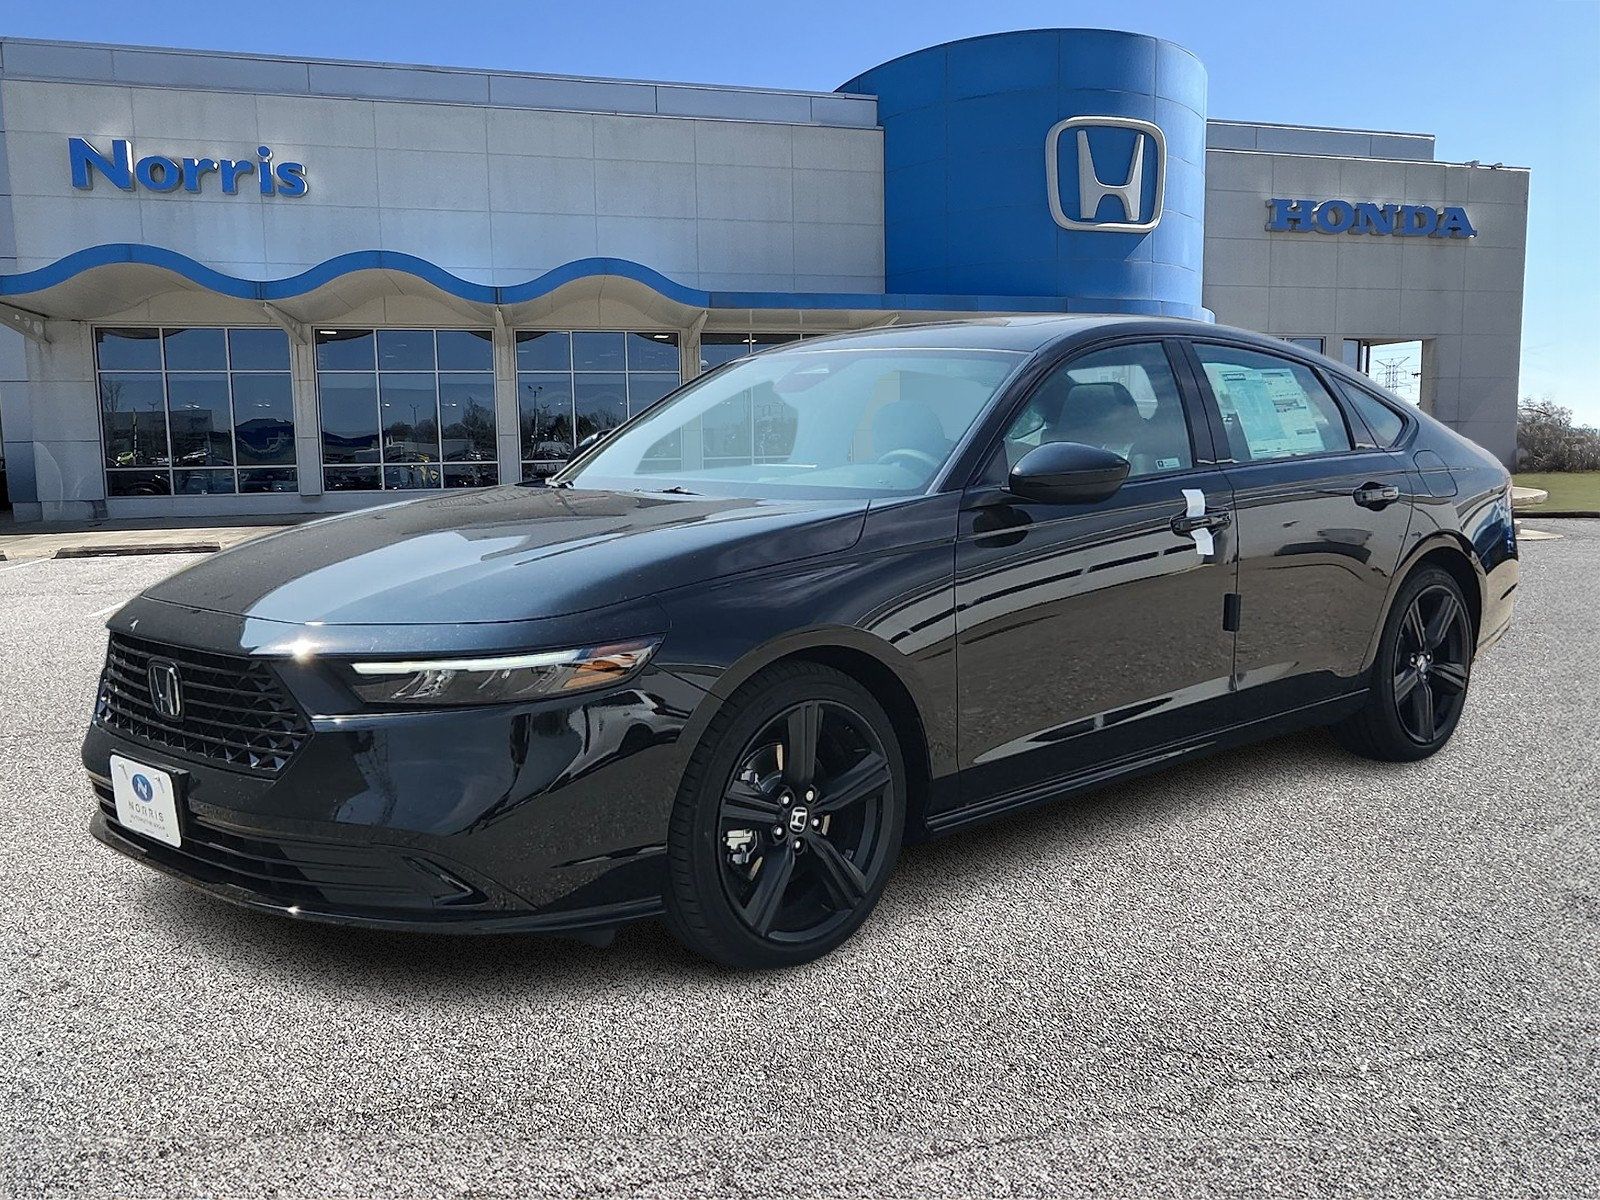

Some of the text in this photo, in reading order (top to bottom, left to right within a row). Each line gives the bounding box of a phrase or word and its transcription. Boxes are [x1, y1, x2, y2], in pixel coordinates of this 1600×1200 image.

[68, 137, 308, 197] Norris
[1265, 198, 1477, 239] HONDA
[128, 800, 165, 822] NORRIS
